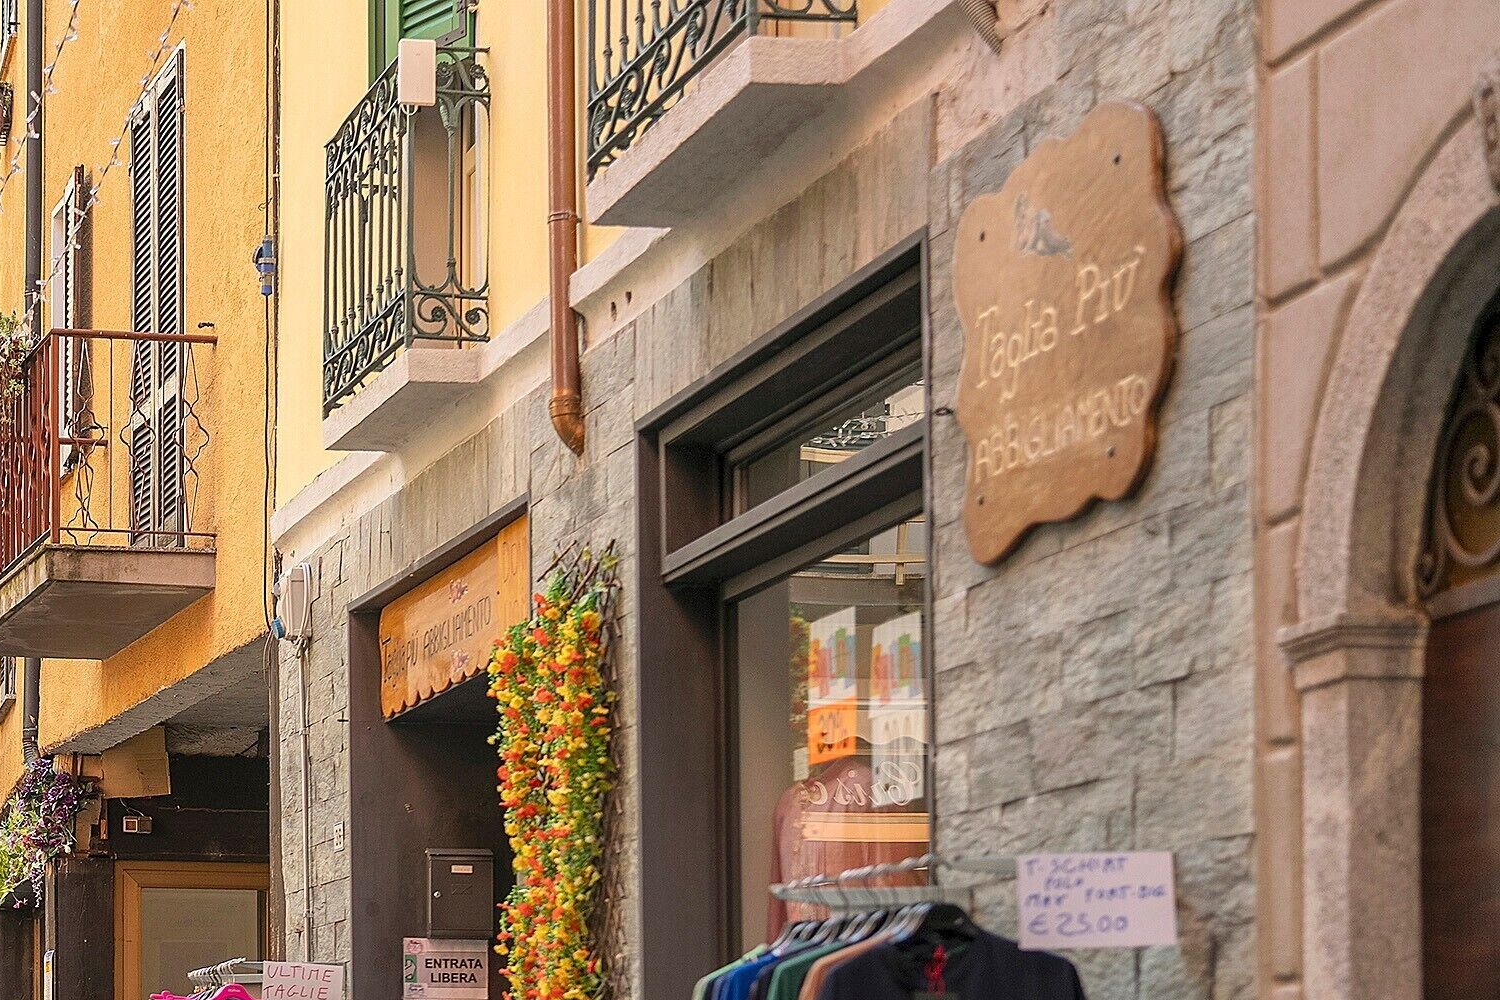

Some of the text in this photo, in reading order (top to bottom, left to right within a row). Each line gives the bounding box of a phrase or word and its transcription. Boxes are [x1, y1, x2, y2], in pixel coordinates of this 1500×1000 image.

[975, 299, 1059, 403] Taglia
[424, 958, 484, 970] ENTRATA
[267, 965, 335, 983] ULTIME
[430, 972, 478, 984] LIBERA
[263, 983, 329, 1000] TAGLIE
